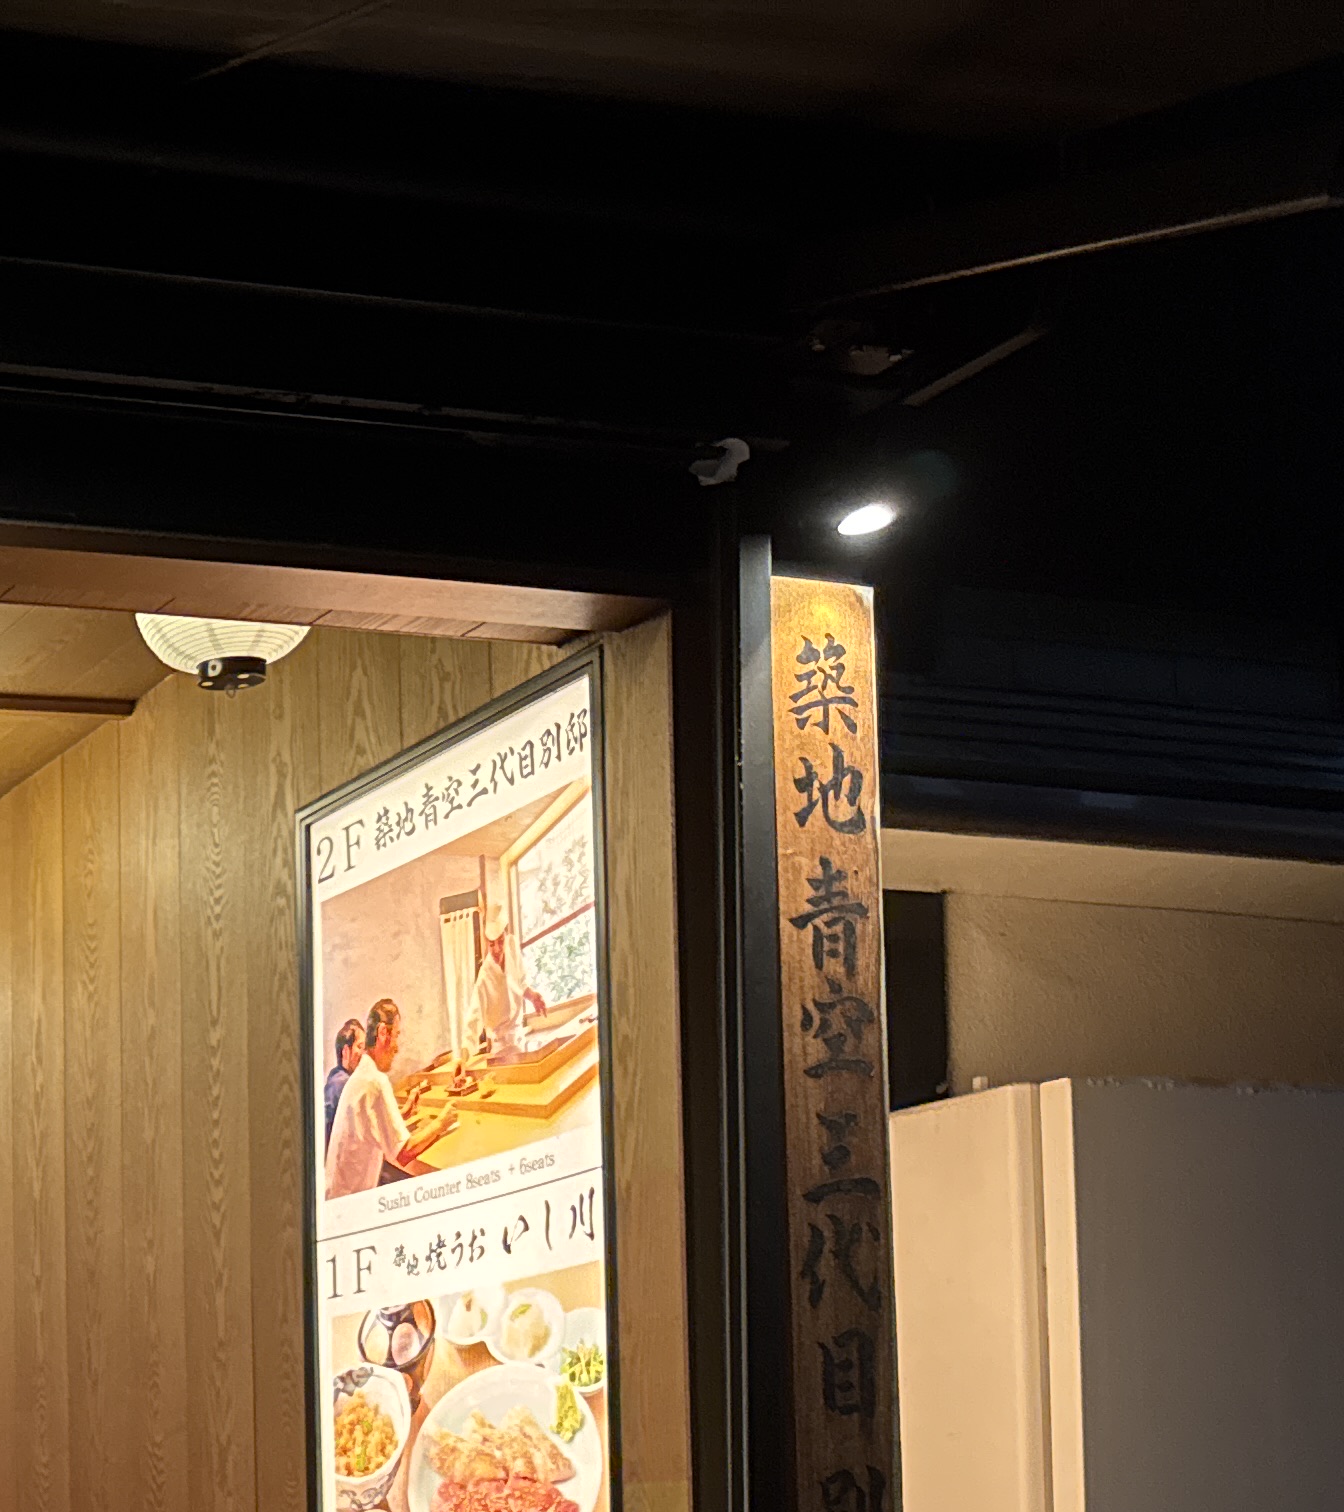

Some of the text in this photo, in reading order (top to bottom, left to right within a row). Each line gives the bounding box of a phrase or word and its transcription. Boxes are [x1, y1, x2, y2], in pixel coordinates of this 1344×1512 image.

[316, 708, 589, 884] 2F 築地青空三代目別邸
[377, 1191, 411, 1214] Sushi
[413, 1179, 462, 1204] Counter
[326, 1245, 377, 1300] 1F
